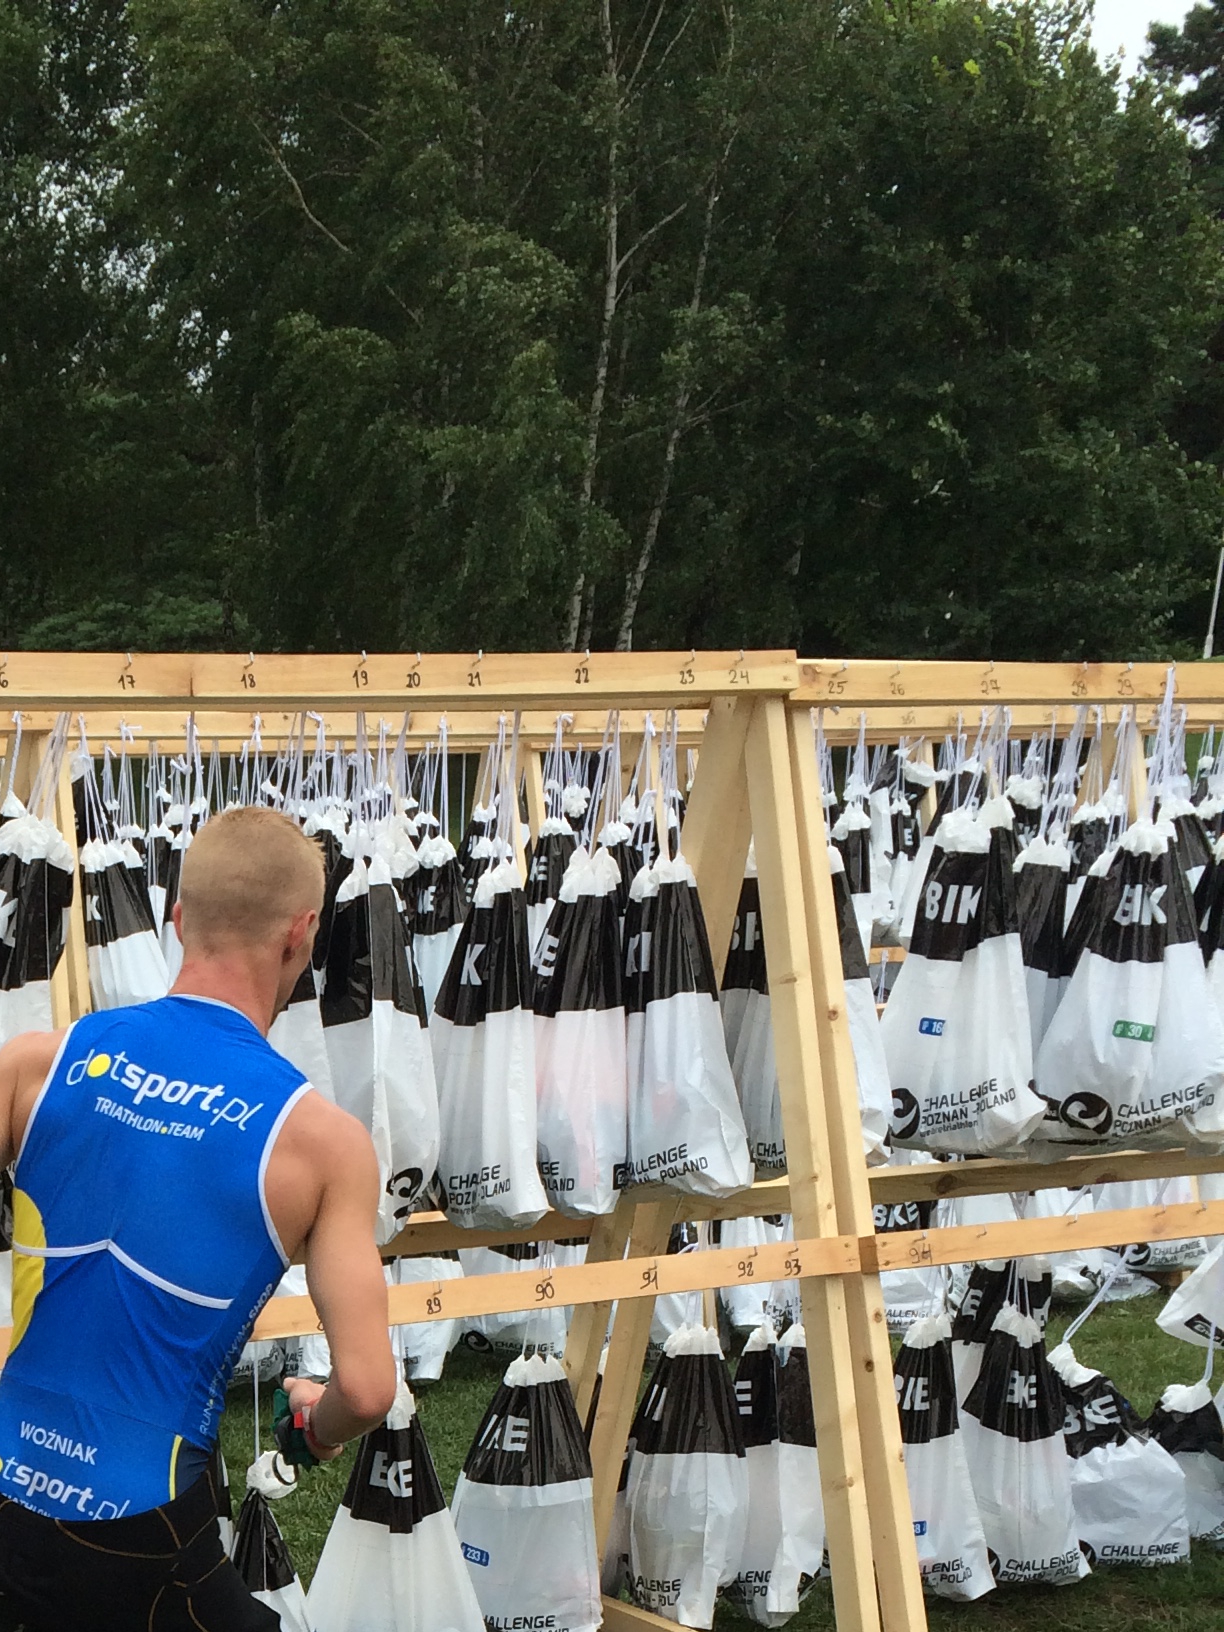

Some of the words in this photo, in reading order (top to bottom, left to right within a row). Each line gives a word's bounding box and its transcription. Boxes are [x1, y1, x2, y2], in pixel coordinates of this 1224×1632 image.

[117, 674, 136, 690] 17
[240, 673, 256, 689] 18
[352, 669, 368, 687] 19
[406, 673, 421, 688] 20
[467, 671, 482, 687] 21
[574, 667, 590, 684] 22
[679, 669, 696, 685] 23
[728, 668, 750, 685] 24
[827, 680, 849, 695] 25
[890, 682, 905, 696] 26
[981, 679, 1002, 694] 27
[1071, 679, 1088, 697] 28
[66, 1048, 264, 1131] dotsport.pl
[659, 1156, 709, 1183] POLAND
[909, 1242, 932, 1264] 94
[737, 1260, 754, 1278] 92
[784, 1258, 802, 1277] 93
[642, 1271, 659, 1291] 91
[535, 1281, 555, 1301] 90
[426, 1297, 442, 1315] 89
[19, 1420, 98, 1466] WOŹNIAK
[1101, 1542, 1180, 1557] CHALLENGE
